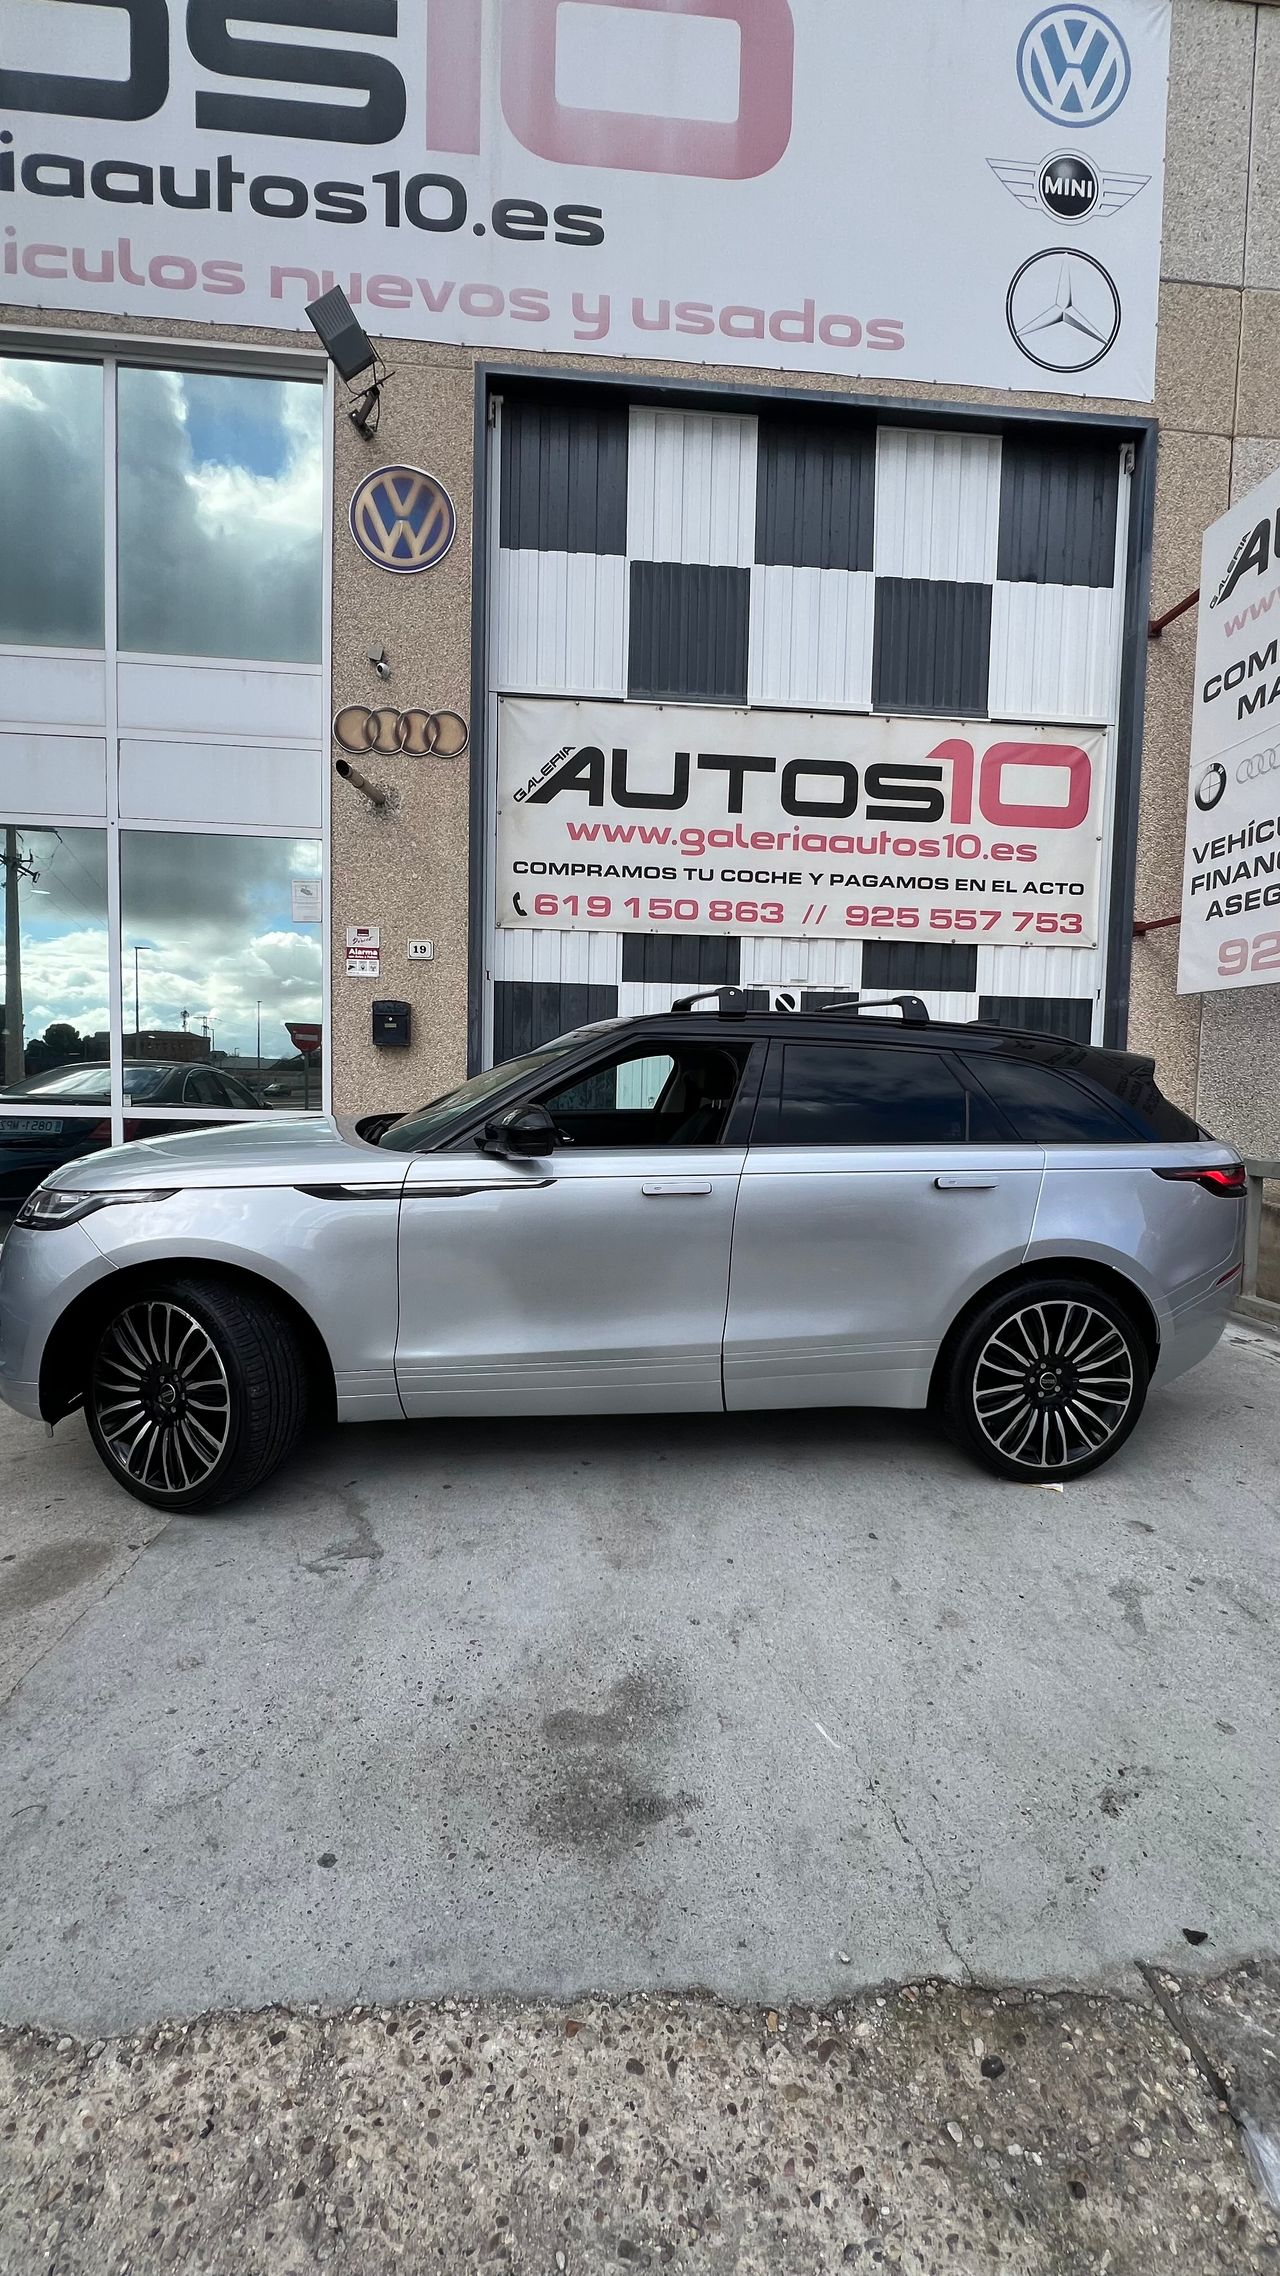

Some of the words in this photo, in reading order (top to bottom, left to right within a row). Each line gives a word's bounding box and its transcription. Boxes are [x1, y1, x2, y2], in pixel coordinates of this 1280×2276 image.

[1044, 176, 1094, 199] MINI
[270, 265, 551, 322] nuevos
[572, 292, 610, 340] y
[632, 297, 905, 351] usados
[1209, 531, 1251, 609] GALERIA
[1223, 586, 1280, 638] ww
[1203, 639, 1278, 703] COM
[512, 746, 577, 803] GALERIA
[525, 738, 1092, 829] AUTOS10
[566, 821, 1039, 863] www.galeriaautos10.es
[1192, 816, 1280, 864] VEHÍC
[512, 860, 677, 880] COMPRAMOS
[683, 867, 714, 882] TU
[720, 869, 803, 885] COCHE
[808, 872, 825, 886] Y
[829, 873, 949, 891] PAGAMOS
[955, 878, 986, 892] EN
[991, 880, 1018, 893] EL
[1022, 881, 1085, 896] ACTO
[1191, 850, 1280, 895] FINAN
[534, 894, 612, 918] 619
[624, 896, 700, 921] 150
[708, 899, 785, 925] 863
[845, 906, 920, 928] 925
[929, 909, 1002, 932] 557
[1012, 911, 1083, 934] 753
[413, 945, 427, 954] 19
[1217, 930, 1280, 976] 92
